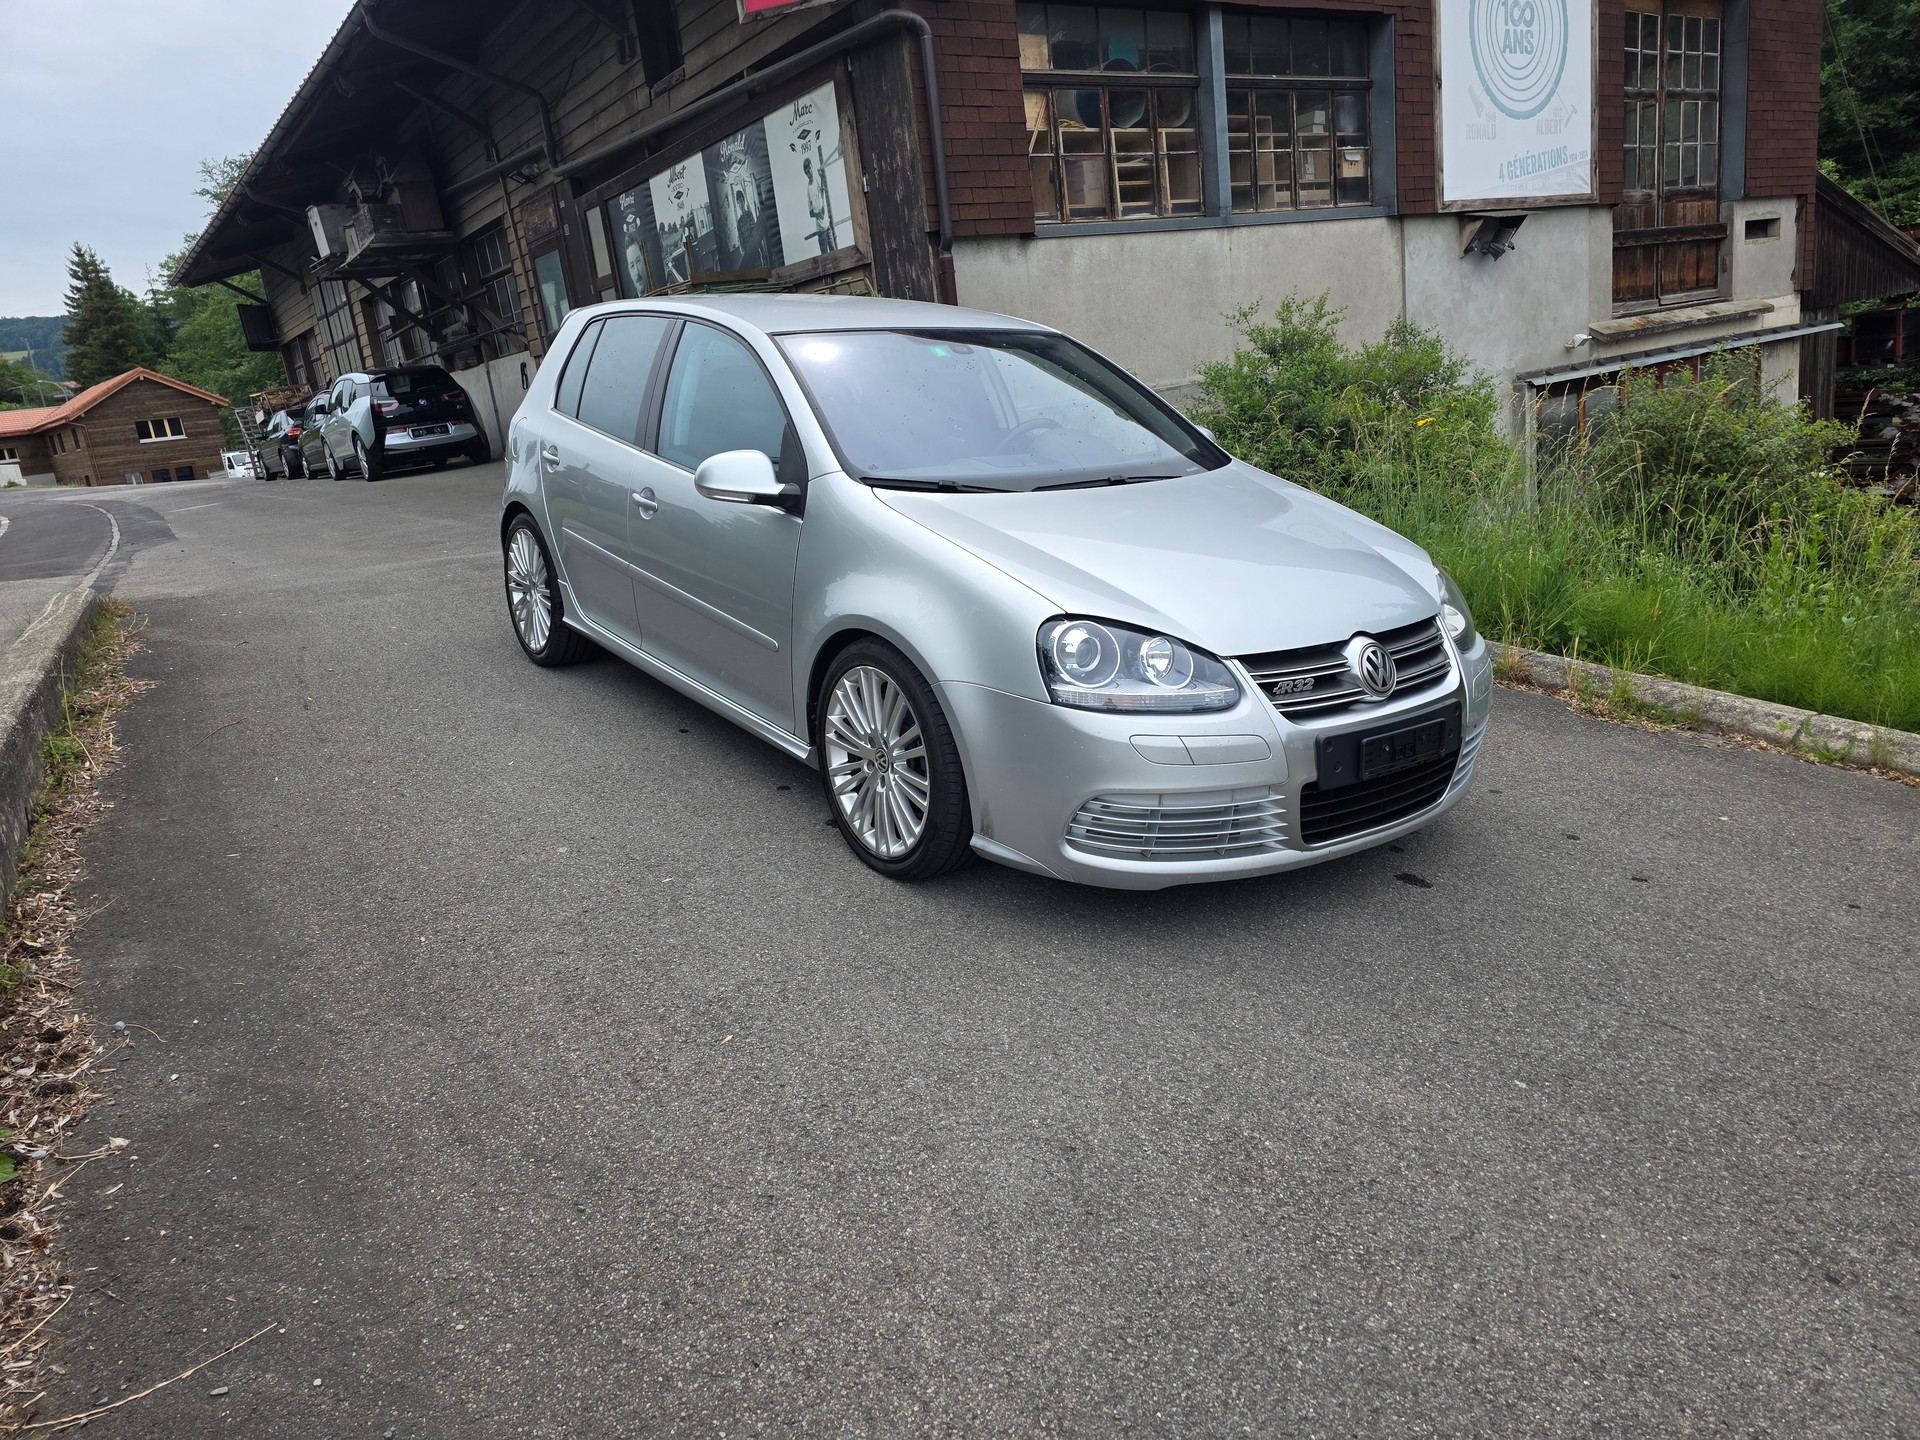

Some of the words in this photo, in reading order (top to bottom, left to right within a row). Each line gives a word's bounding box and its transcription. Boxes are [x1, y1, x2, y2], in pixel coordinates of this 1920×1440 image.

[1502, 0, 1534, 28] 100
[1502, 28, 1534, 55] ANS
[789, 99, 813, 126] Marc
[1466, 123, 1496, 141] RONALD
[1536, 119, 1562, 135] ALBERT
[720, 133, 745, 162] Ronald
[1498, 162, 1505, 183] 4
[1506, 145, 1568, 181] GÉNÉRATIONS
